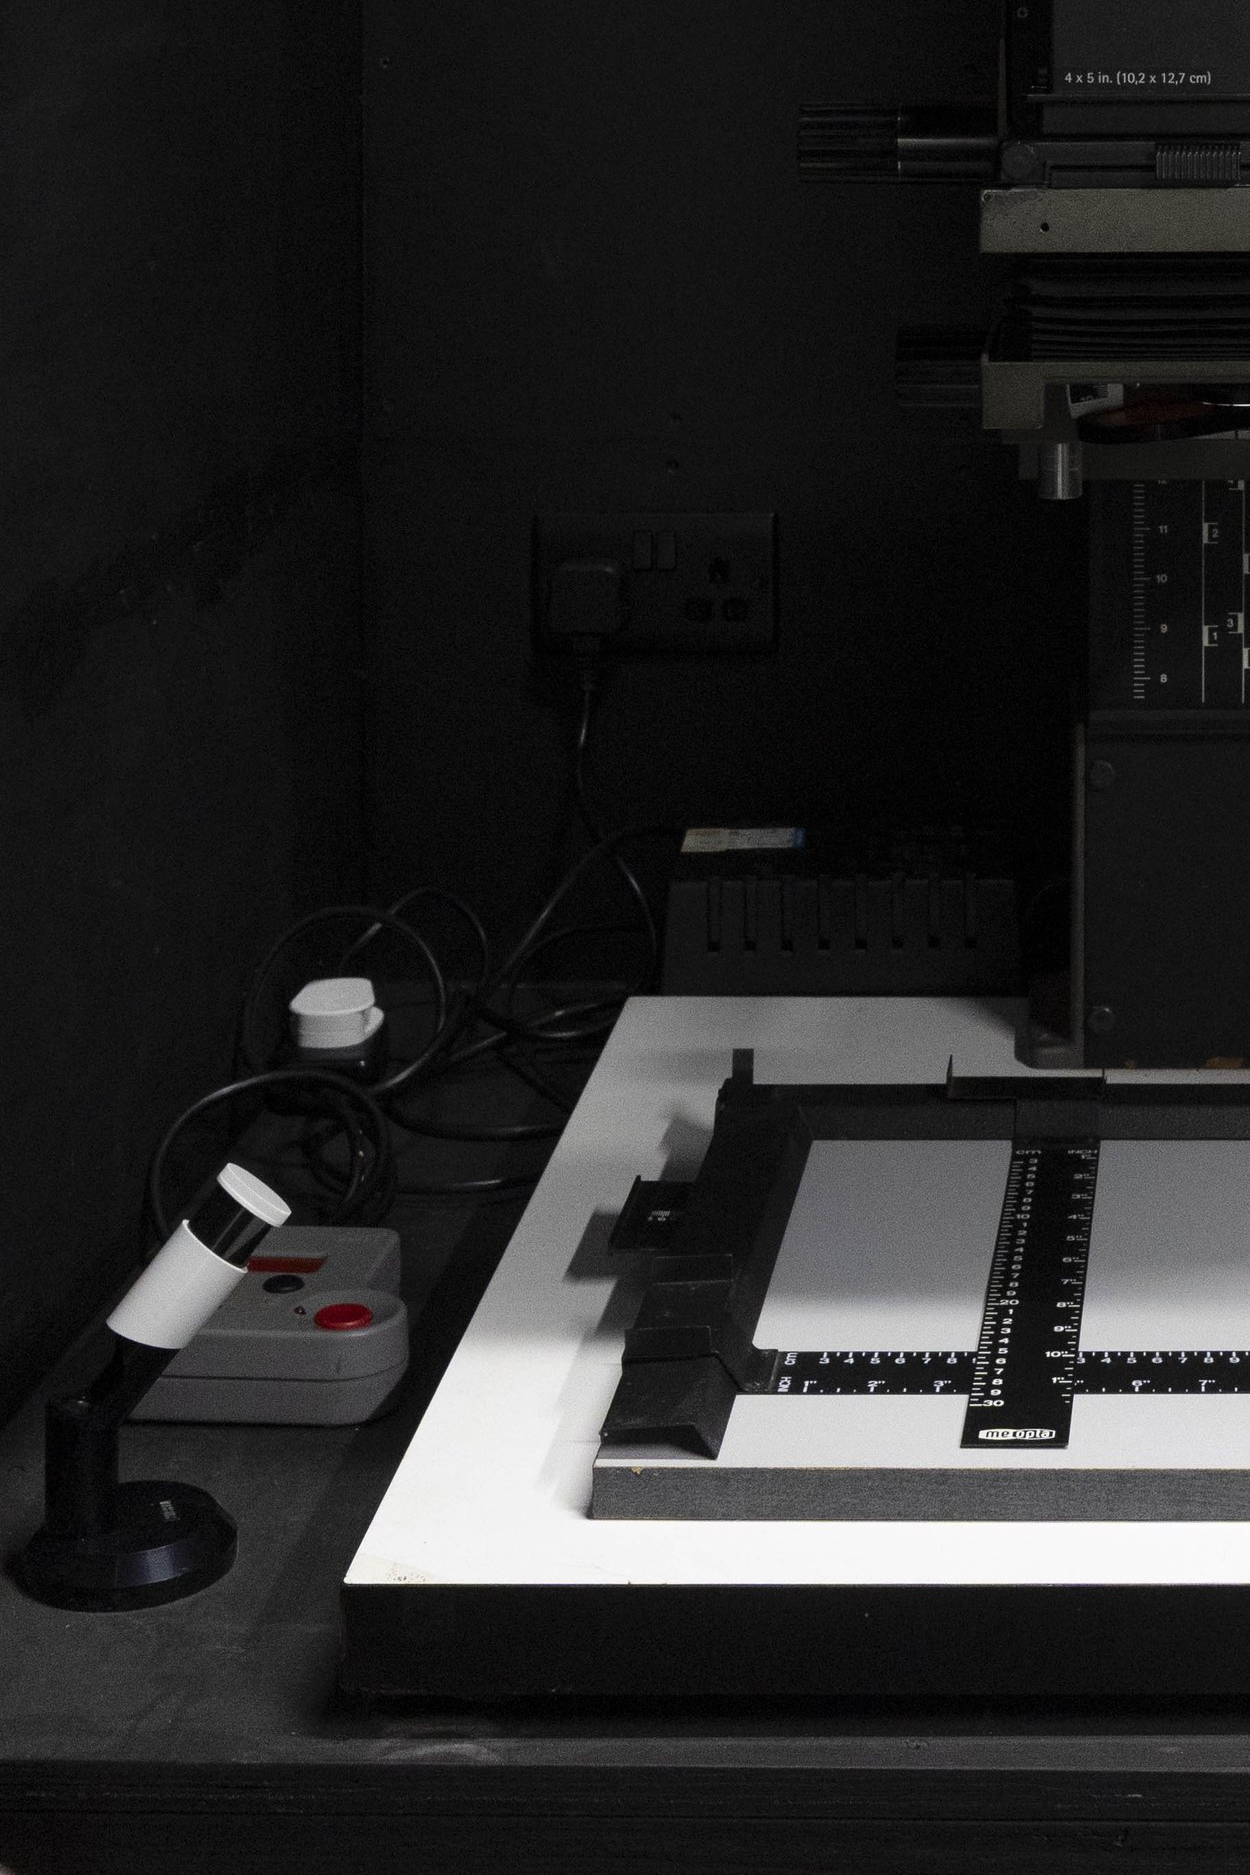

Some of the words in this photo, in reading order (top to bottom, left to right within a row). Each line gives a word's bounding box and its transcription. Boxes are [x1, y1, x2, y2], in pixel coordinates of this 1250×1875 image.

[1065, 73, 1072, 83] 4
[1076, 75, 1082, 83] x
[1087, 73, 1094, 83] 5
[1099, 72, 1112, 83] in.
[1117, 71, 1145, 85] (10,2
[1150, 75, 1156, 83] x
[1162, 73, 1185, 85] 12,7
[1190, 71, 1211, 85] cm)
[1159, 525, 1167, 533] 11
[1213, 529, 1218, 537] 2
[1156, 574, 1167, 583] 10
[1227, 619, 1233, 627] 3
[1161, 624, 1167, 633] 9
[1213, 632, 1217, 640] 1
[1160, 674, 1167, 683] 8
[784, 1352, 798, 1365] cm
[777, 1376, 792, 1393] INCH
